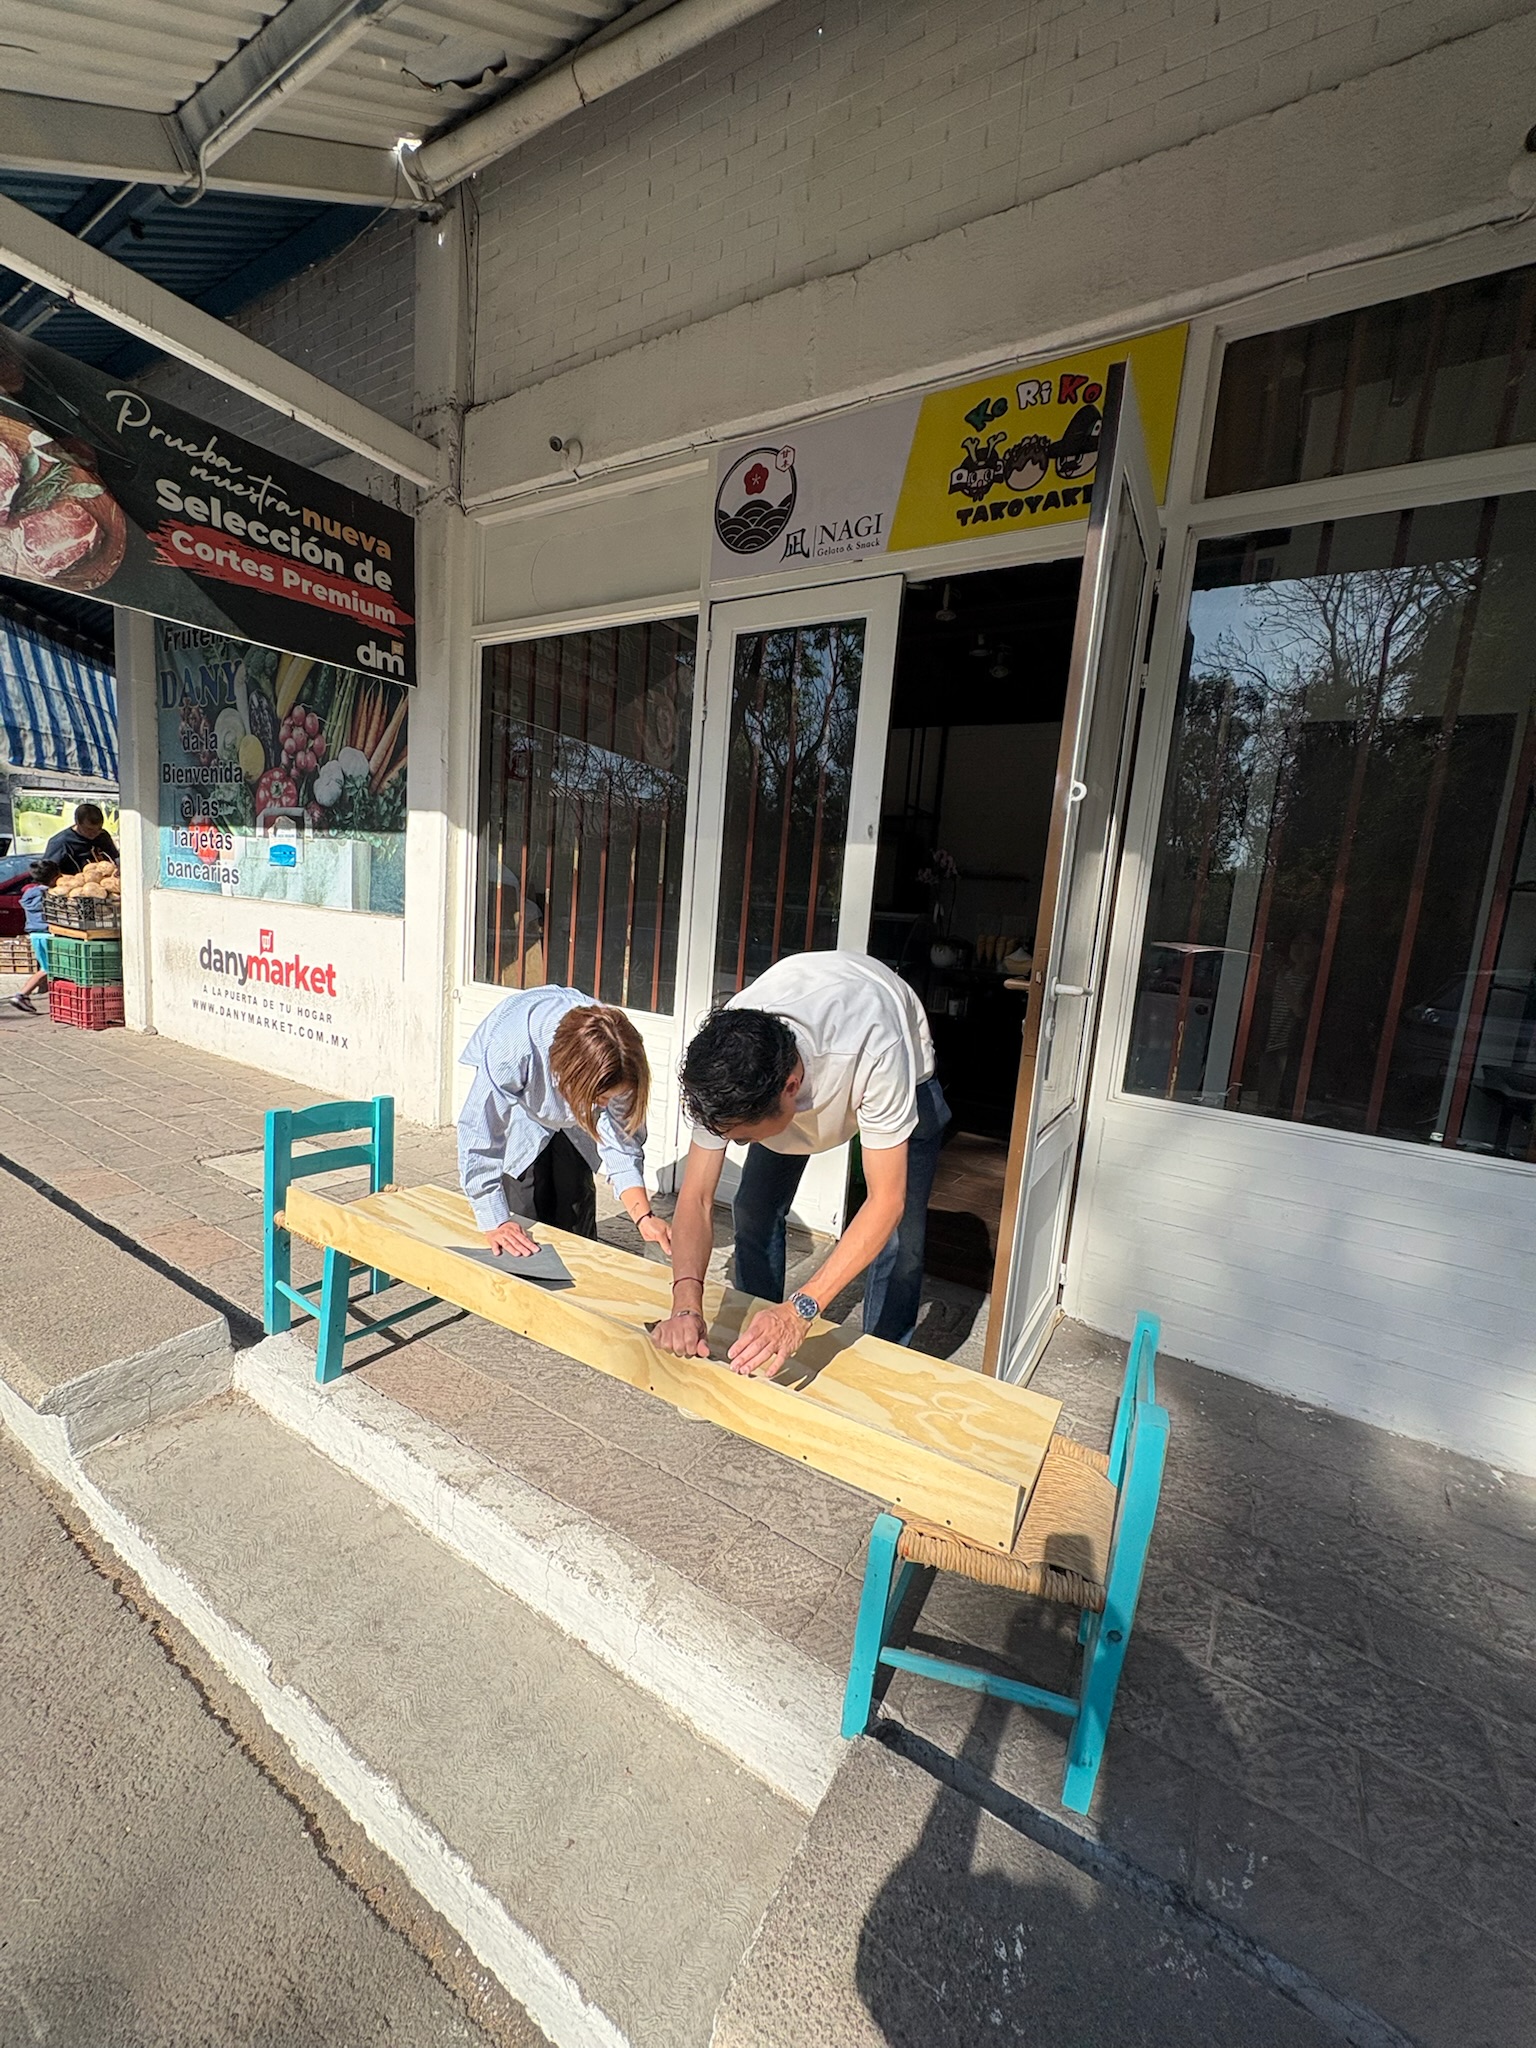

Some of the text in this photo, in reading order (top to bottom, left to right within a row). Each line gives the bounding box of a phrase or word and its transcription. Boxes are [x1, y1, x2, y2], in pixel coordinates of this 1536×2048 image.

[105, 389, 243, 475] Prueba
[190, 453, 392, 560] nuestra nueva
[155, 478, 392, 592] Selección de
[779, 528, 810, 563] 凪
[818, 513, 884, 545] NAGI
[816, 547, 844, 557] Gelato
[855, 538, 881, 549] Snack
[171, 530, 397, 625] Cortes Premium
[356, 641, 404, 676] dm
[160, 659, 243, 709] DANY
[182, 727, 217, 750] da la
[162, 763, 243, 785] Bienvenida
[182, 797, 219, 817] a las
[171, 826, 233, 850] Tarjetas
[168, 857, 240, 885] bancarias
[200, 939, 337, 997] danymarket
[203, 985, 333, 1023] A LA PUERTA DE TU HOGAR
[192, 999, 348, 1049] WWW.DANYMARKET.COM.MX
